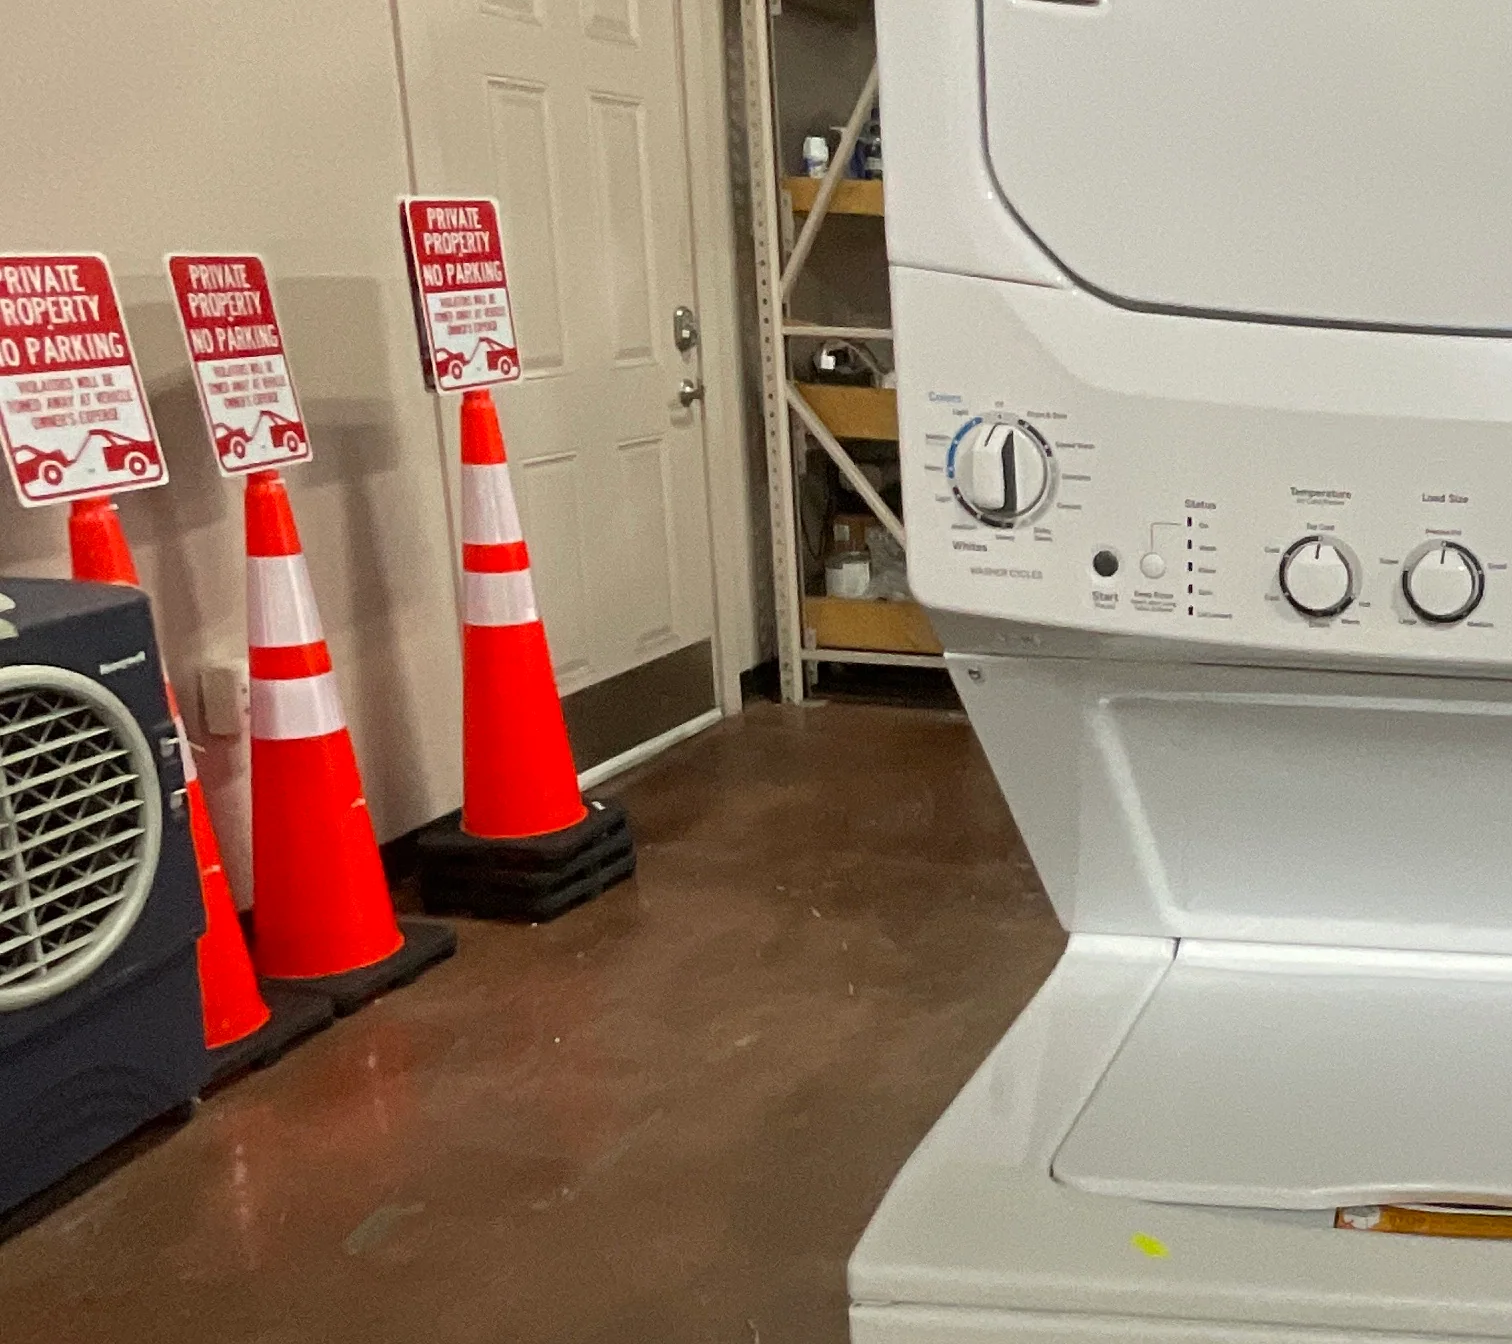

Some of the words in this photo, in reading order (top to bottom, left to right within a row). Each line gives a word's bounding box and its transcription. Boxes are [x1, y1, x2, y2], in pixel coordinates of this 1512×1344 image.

[425, 206, 482, 230] PRIVATE
[422, 231, 490, 255] PROPERTY
[0, 265, 86, 294] RIVATE
[188, 264, 251, 289] PRIVATE
[422, 264, 444, 286] NO
[445, 261, 503, 285] PARKING
[0, 295, 100, 326] ROPERTY
[186, 291, 262, 318] PROPERTY
[0, 338, 20, 367] O
[25, 332, 125, 365] PARKING
[190, 328, 214, 353] NO
[215, 324, 279, 352] PARKING
[1092, 590, 1119, 602] Start
